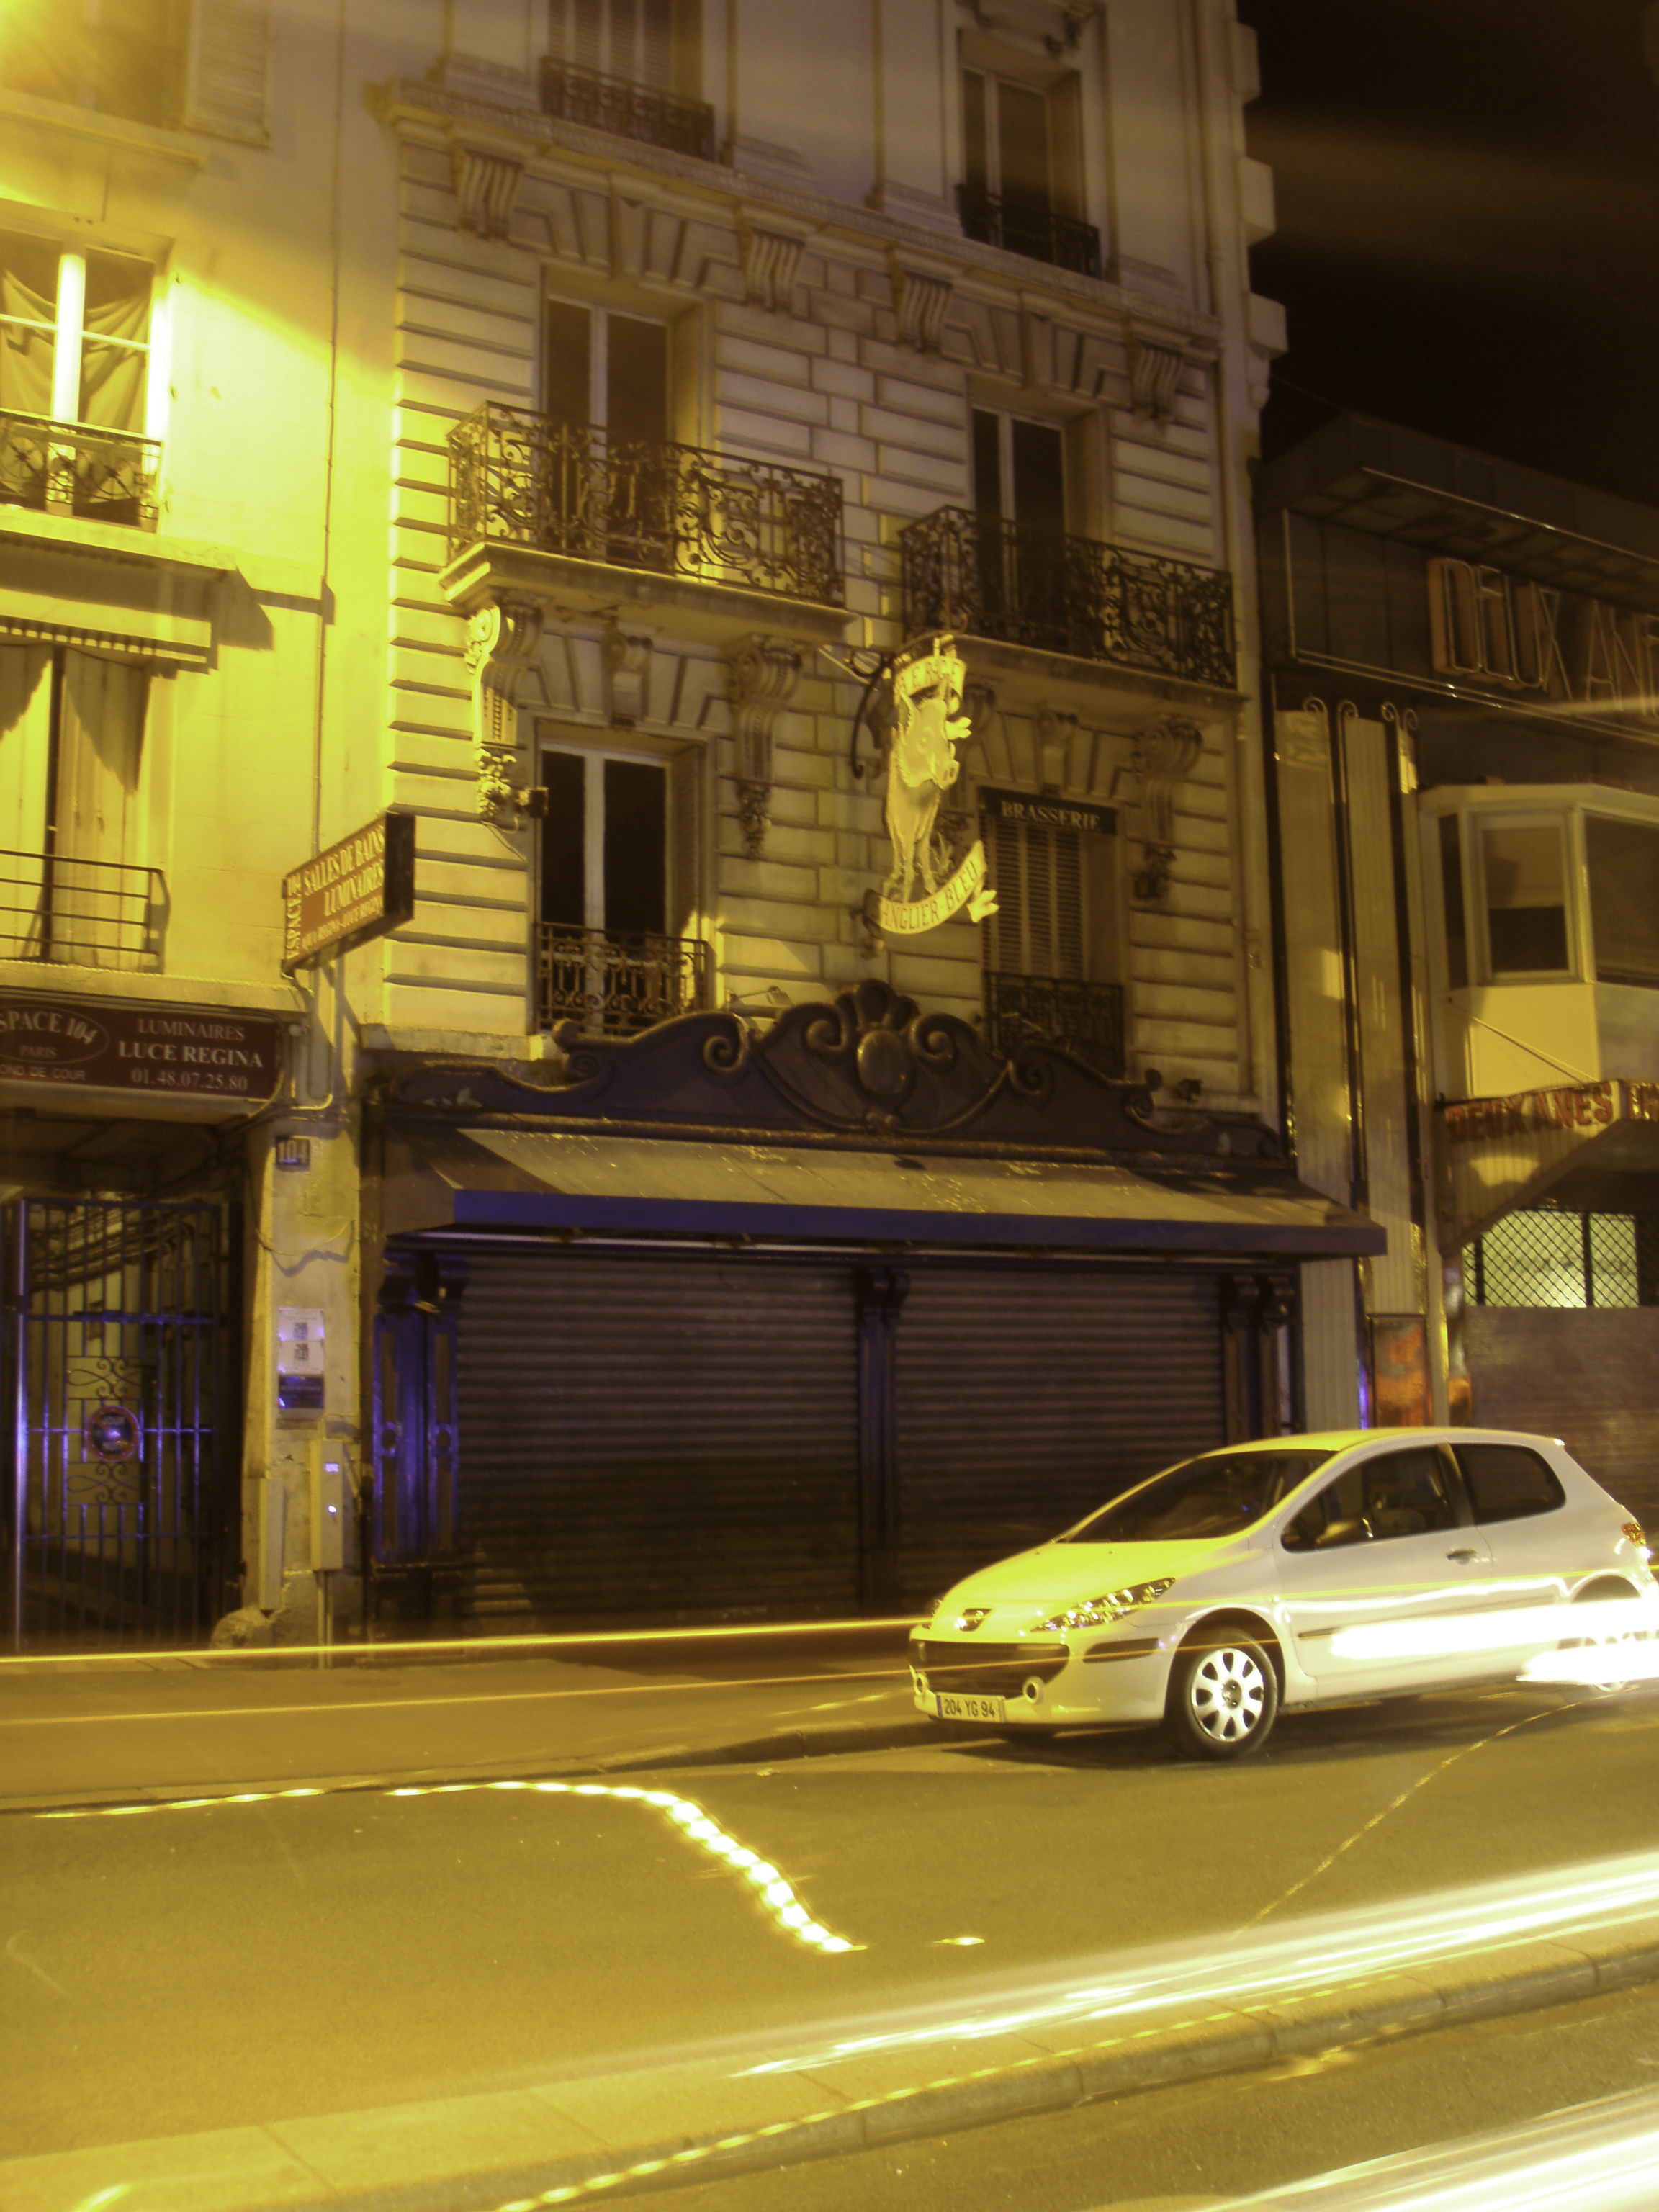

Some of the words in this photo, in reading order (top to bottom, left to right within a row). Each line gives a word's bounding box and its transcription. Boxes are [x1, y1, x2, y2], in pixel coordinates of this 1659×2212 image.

[1002, 801, 1100, 829] BRASSERIE
[944, 861, 978, 910] BLEU
[66, 1018, 98, 1045] 104
[138, 1018, 246, 1041] LUMINAIRES
[19, 1045, 58, 1058] PARIS
[118, 1041, 177, 1061] LUCE
[182, 1046, 264, 1068] REGINA
[30, 1066, 47, 1078] DE
[52, 1068, 85, 1080] COUR
[131, 1069, 248, 1092] 01.48.07.25.80
[1445, 1096, 1527, 1143] DEUX
[278, 1141, 307, 1163] 104
[944, 1699, 962, 1716] 204
[965, 1700, 978, 1717] YG
[981, 1701, 995, 1718] 94
